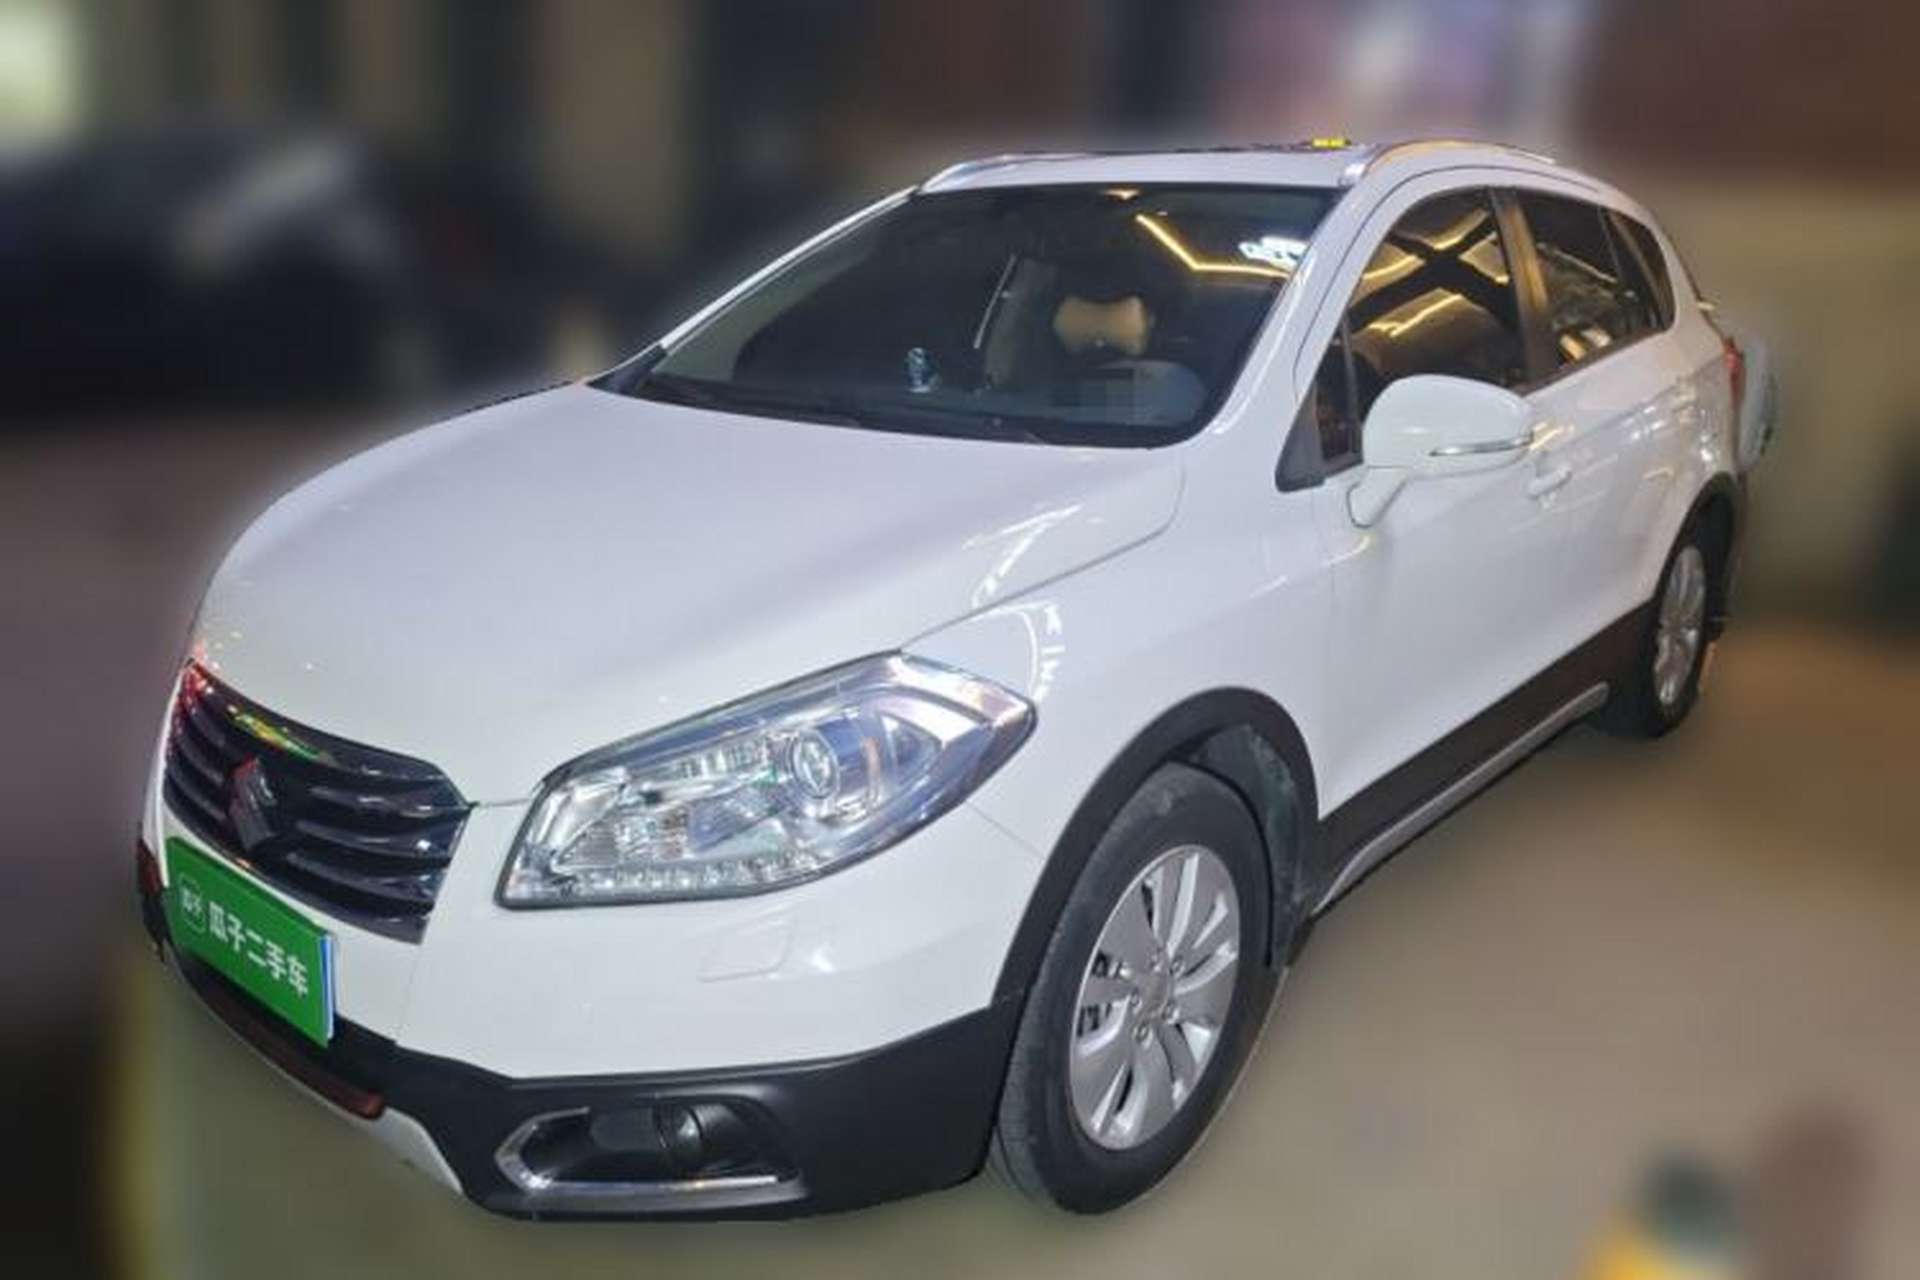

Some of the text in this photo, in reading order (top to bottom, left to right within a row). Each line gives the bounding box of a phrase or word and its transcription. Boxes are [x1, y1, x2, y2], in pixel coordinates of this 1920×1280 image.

[209, 901, 308, 998] 瓜子二手车
